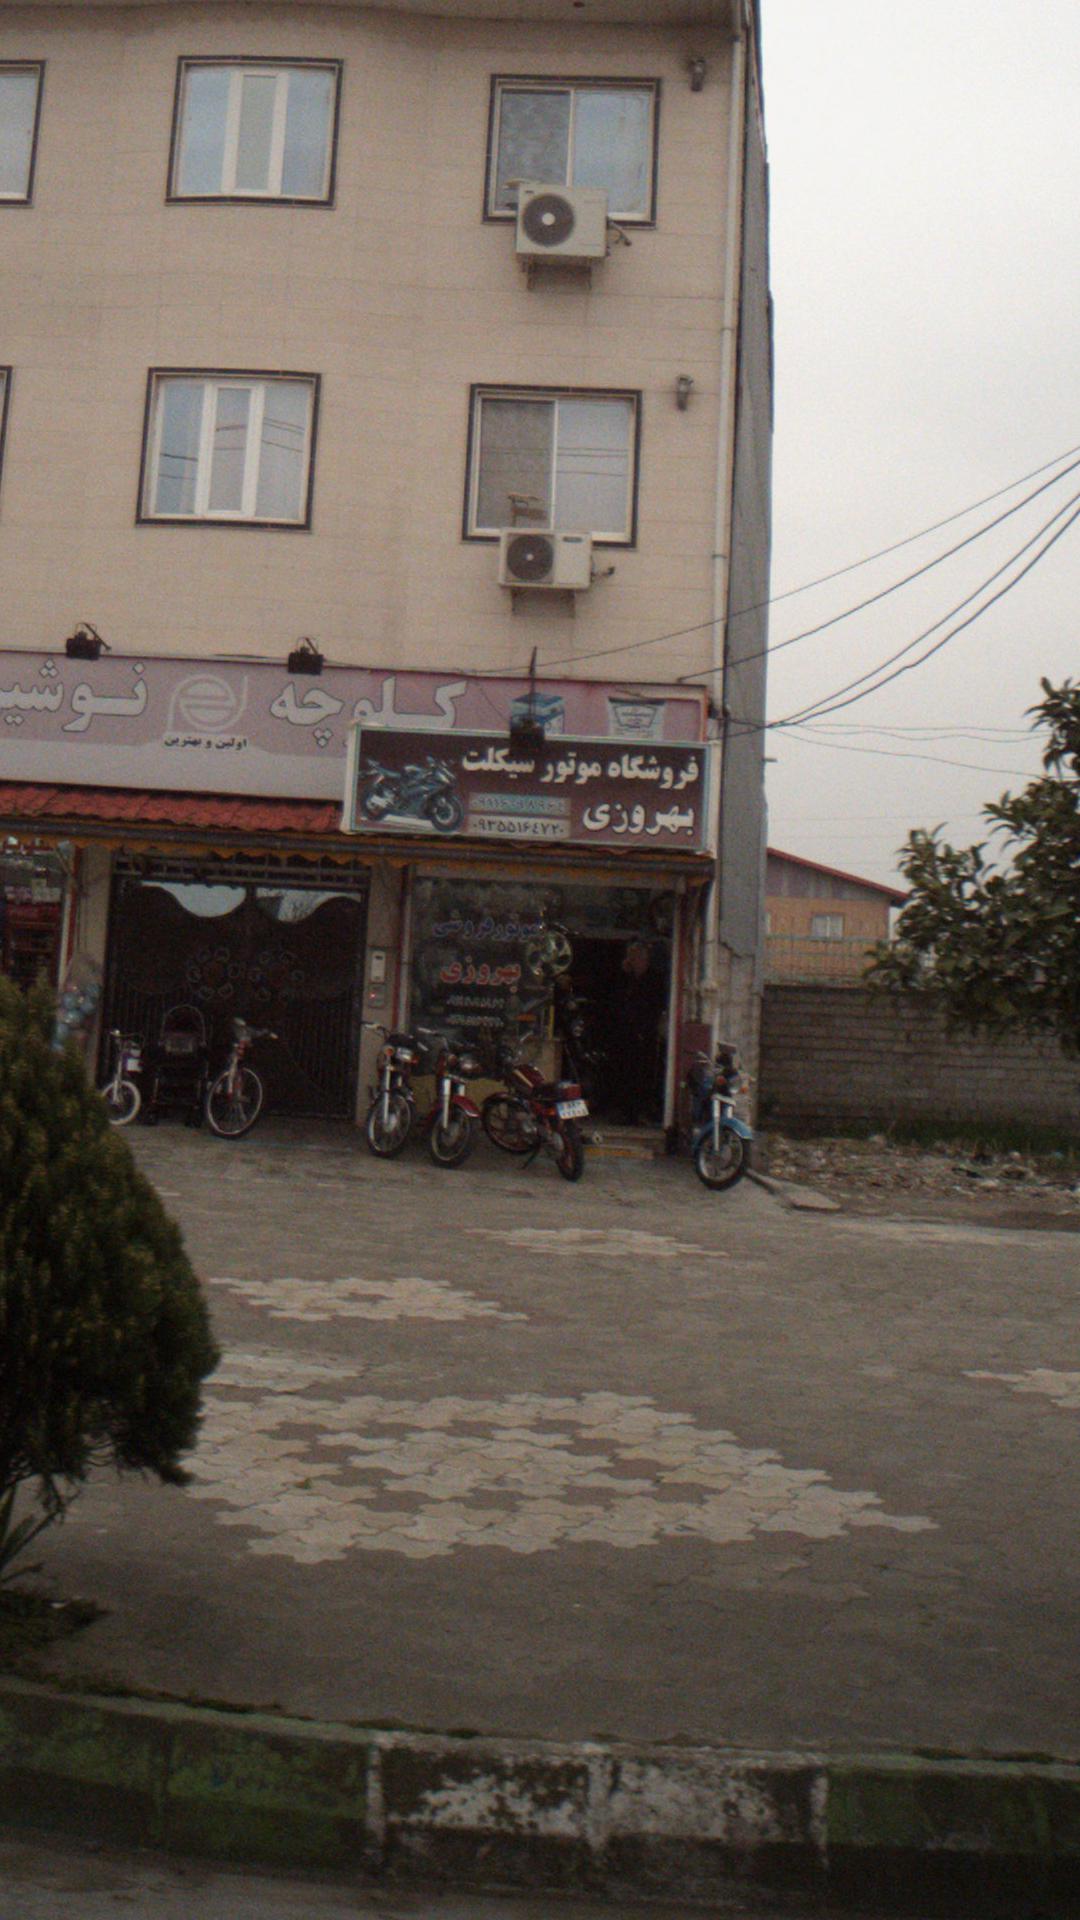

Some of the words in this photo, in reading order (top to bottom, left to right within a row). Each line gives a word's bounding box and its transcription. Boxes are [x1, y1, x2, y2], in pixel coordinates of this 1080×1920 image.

[0, 657, 148, 732] نوشی
[215, 737, 247, 750] اولین
[462, 748, 536, 778] سیکلت
[540, 753, 602, 784] موتور
[608, 754, 699, 789] فروشگاه
[583, 803, 694, 836] بهروزی
[440, 955, 521, 993] بهروزی
